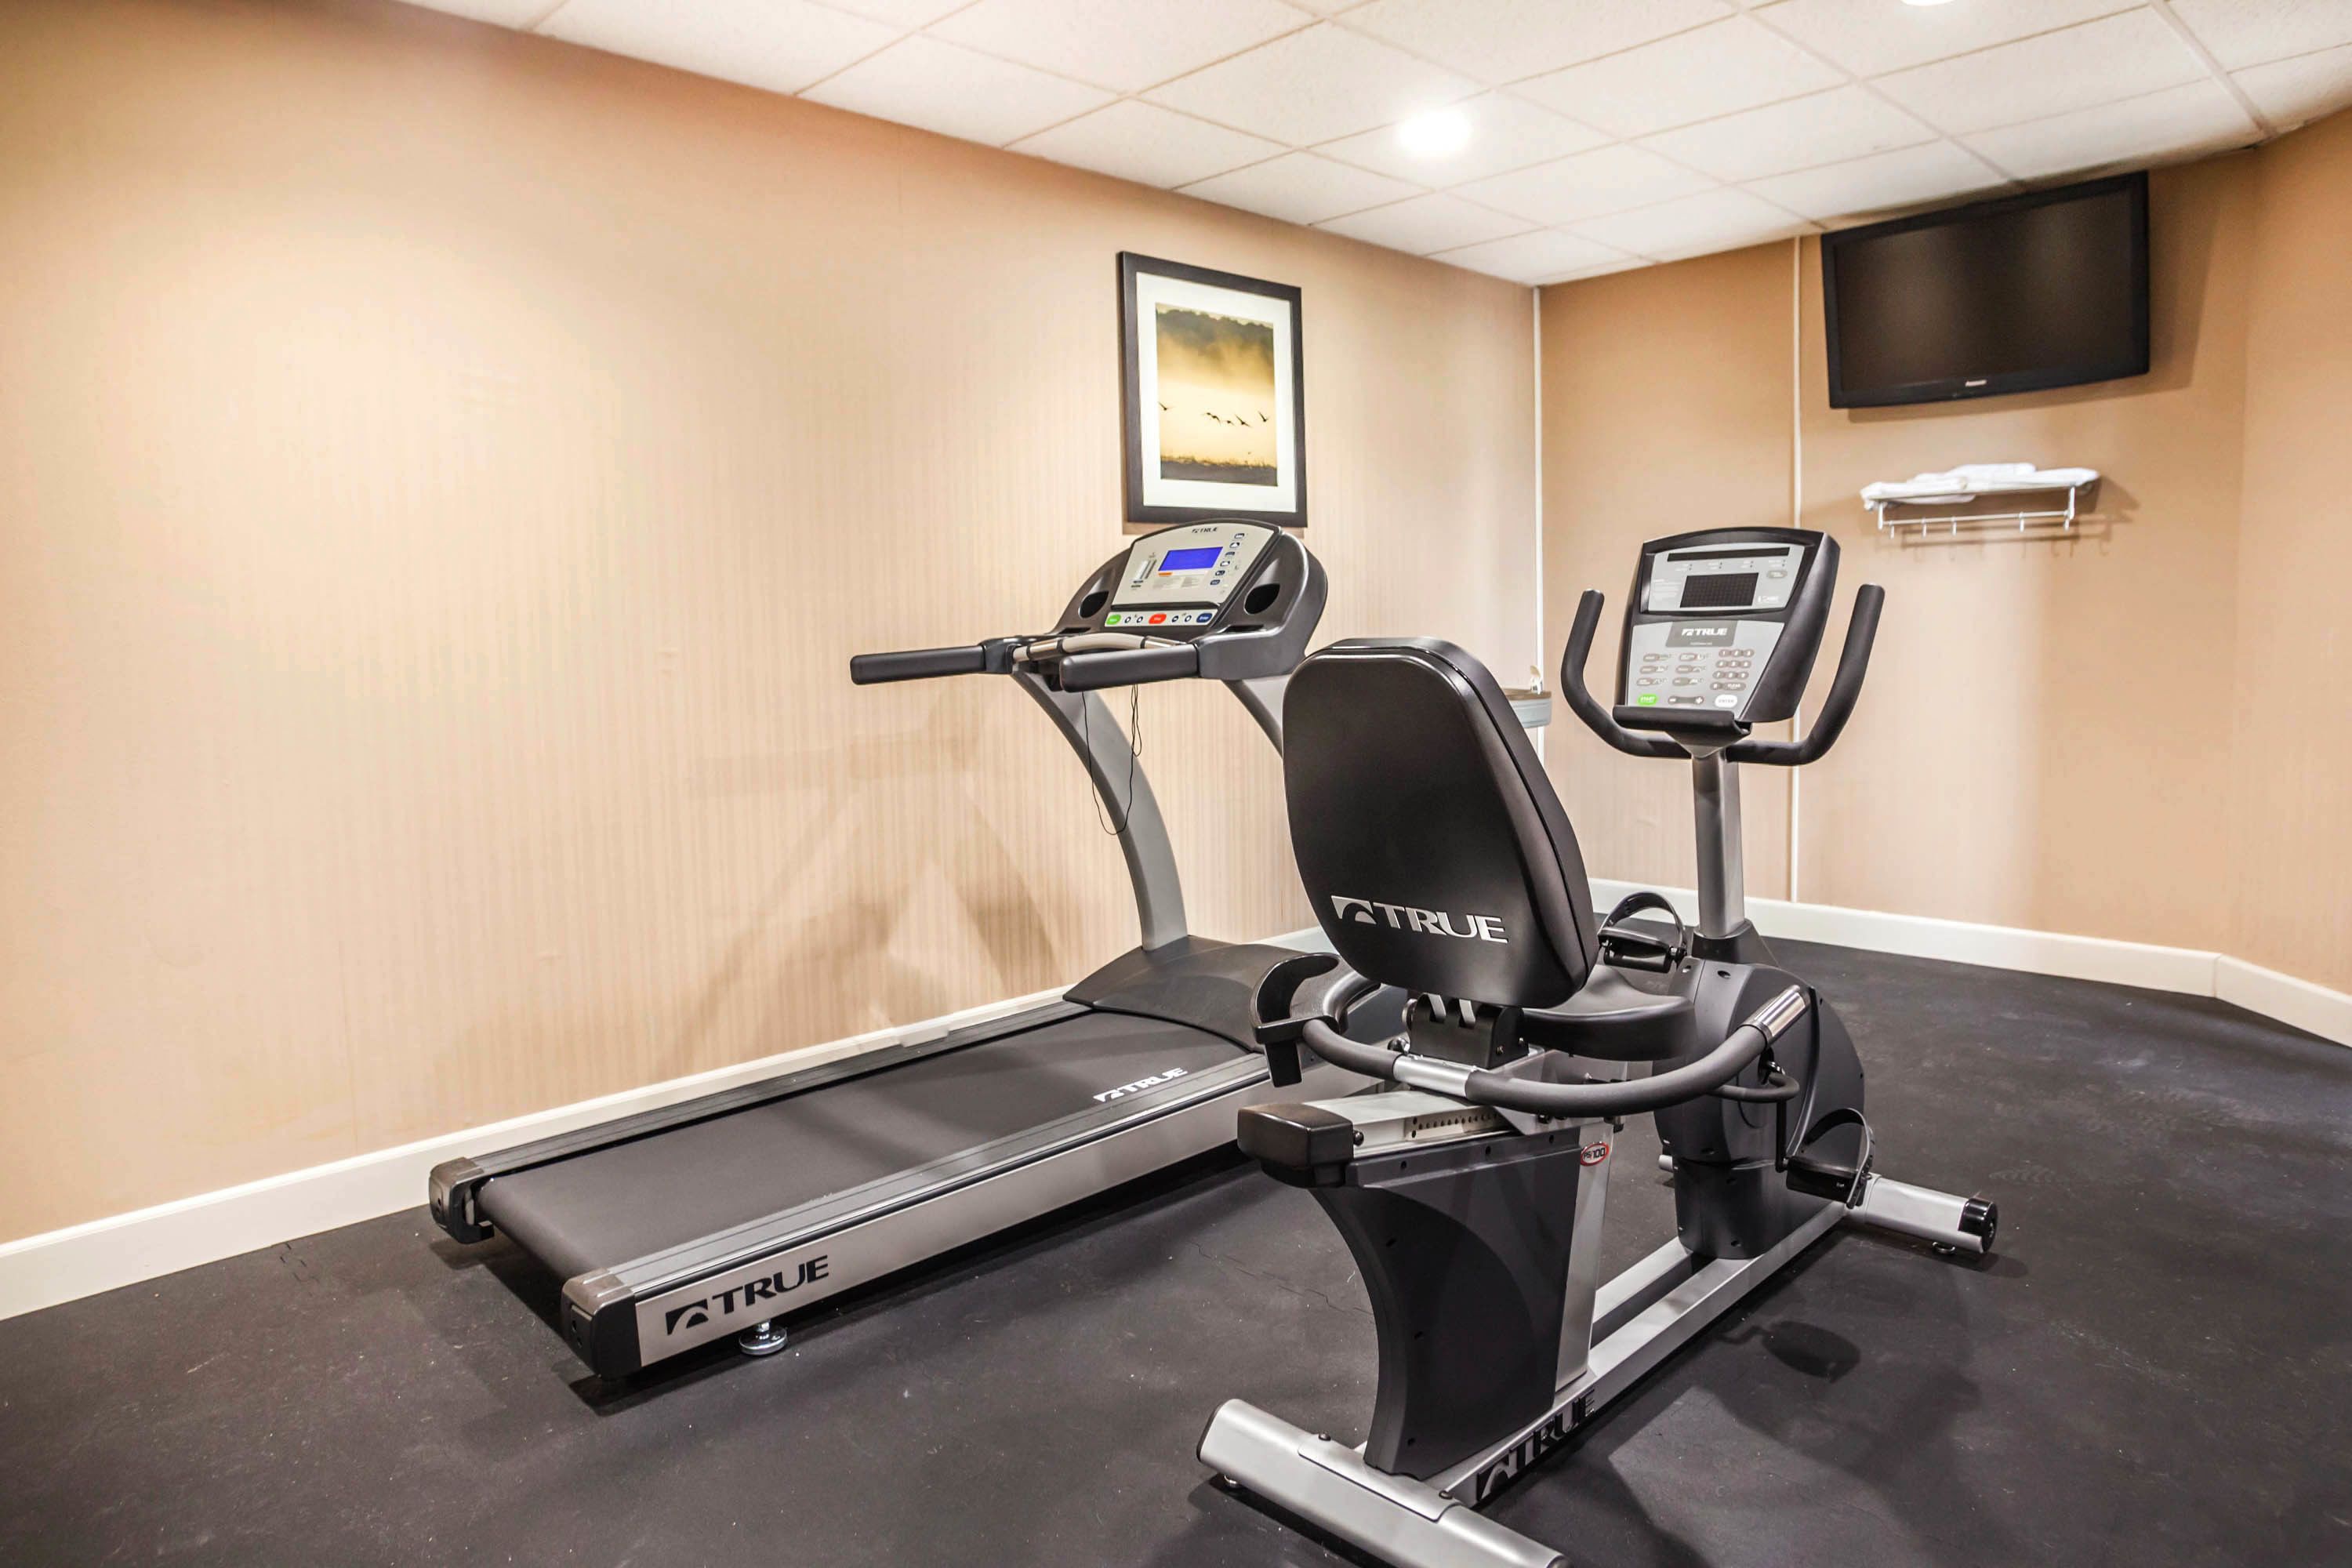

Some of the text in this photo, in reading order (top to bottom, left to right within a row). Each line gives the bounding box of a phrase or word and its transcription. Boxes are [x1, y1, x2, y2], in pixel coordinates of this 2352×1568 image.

[1694, 627, 1728, 636] TRUE
[1372, 902, 1508, 944] TRUE
[1116, 1067, 1189, 1092] TRUE
[712, 1254, 829, 1314] TRUE
[1509, 1388, 1595, 1468] TRUE
